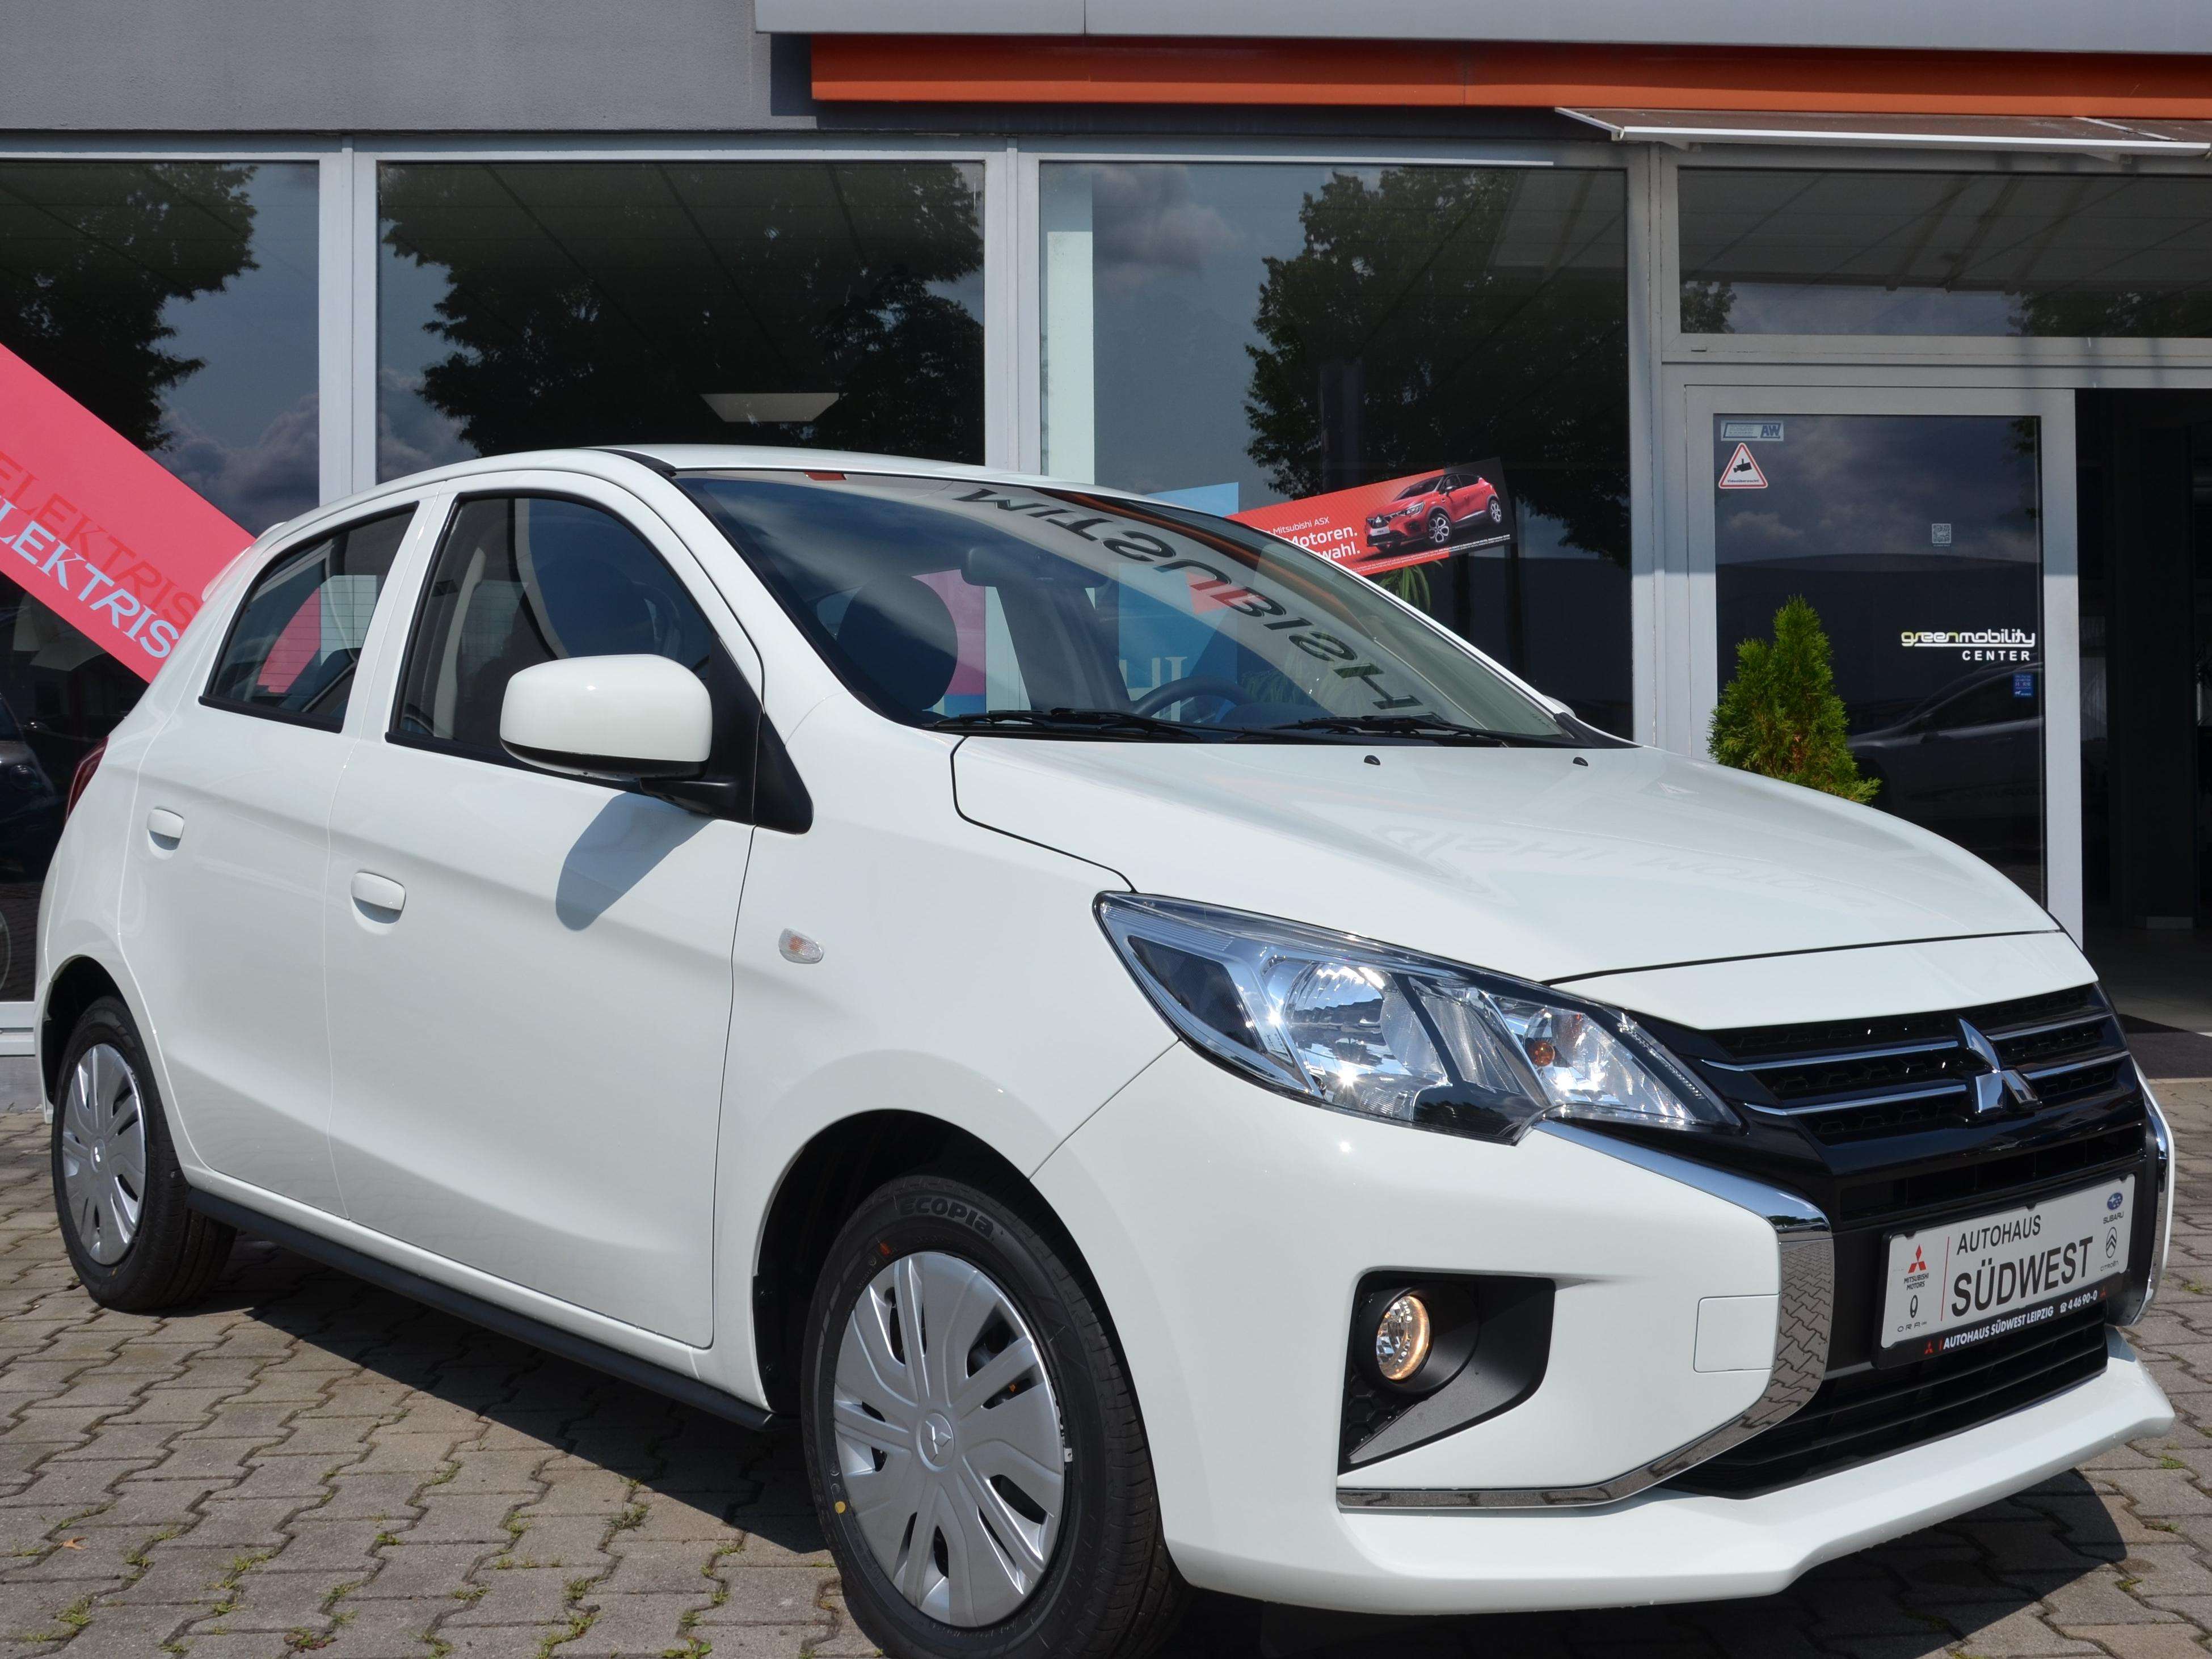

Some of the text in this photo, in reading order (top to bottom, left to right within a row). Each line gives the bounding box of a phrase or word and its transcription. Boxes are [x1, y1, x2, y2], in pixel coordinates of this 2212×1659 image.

[1273, 516, 1330, 535] Mitsubishi ASX
[1901, 628, 2036, 647] greenmobility
[1962, 651, 2030, 661] CENTER
[2103, 1211, 2124, 1224] SUBARU
[1956, 1214, 2041, 1255] AUTOHAUS
[1903, 1272, 1929, 1284] MITSUBISHI
[1951, 1236, 2093, 1317] SÜDWEST
[1906, 1281, 1925, 1290] MOTORS
[1897, 1322, 1920, 1332] ORA
[1943, 1325, 1990, 1349] AUTOHAUS
[1991, 1314, 2026, 1336] SÜDWEST
[2026, 1306, 2054, 1324] LEIPZIG
